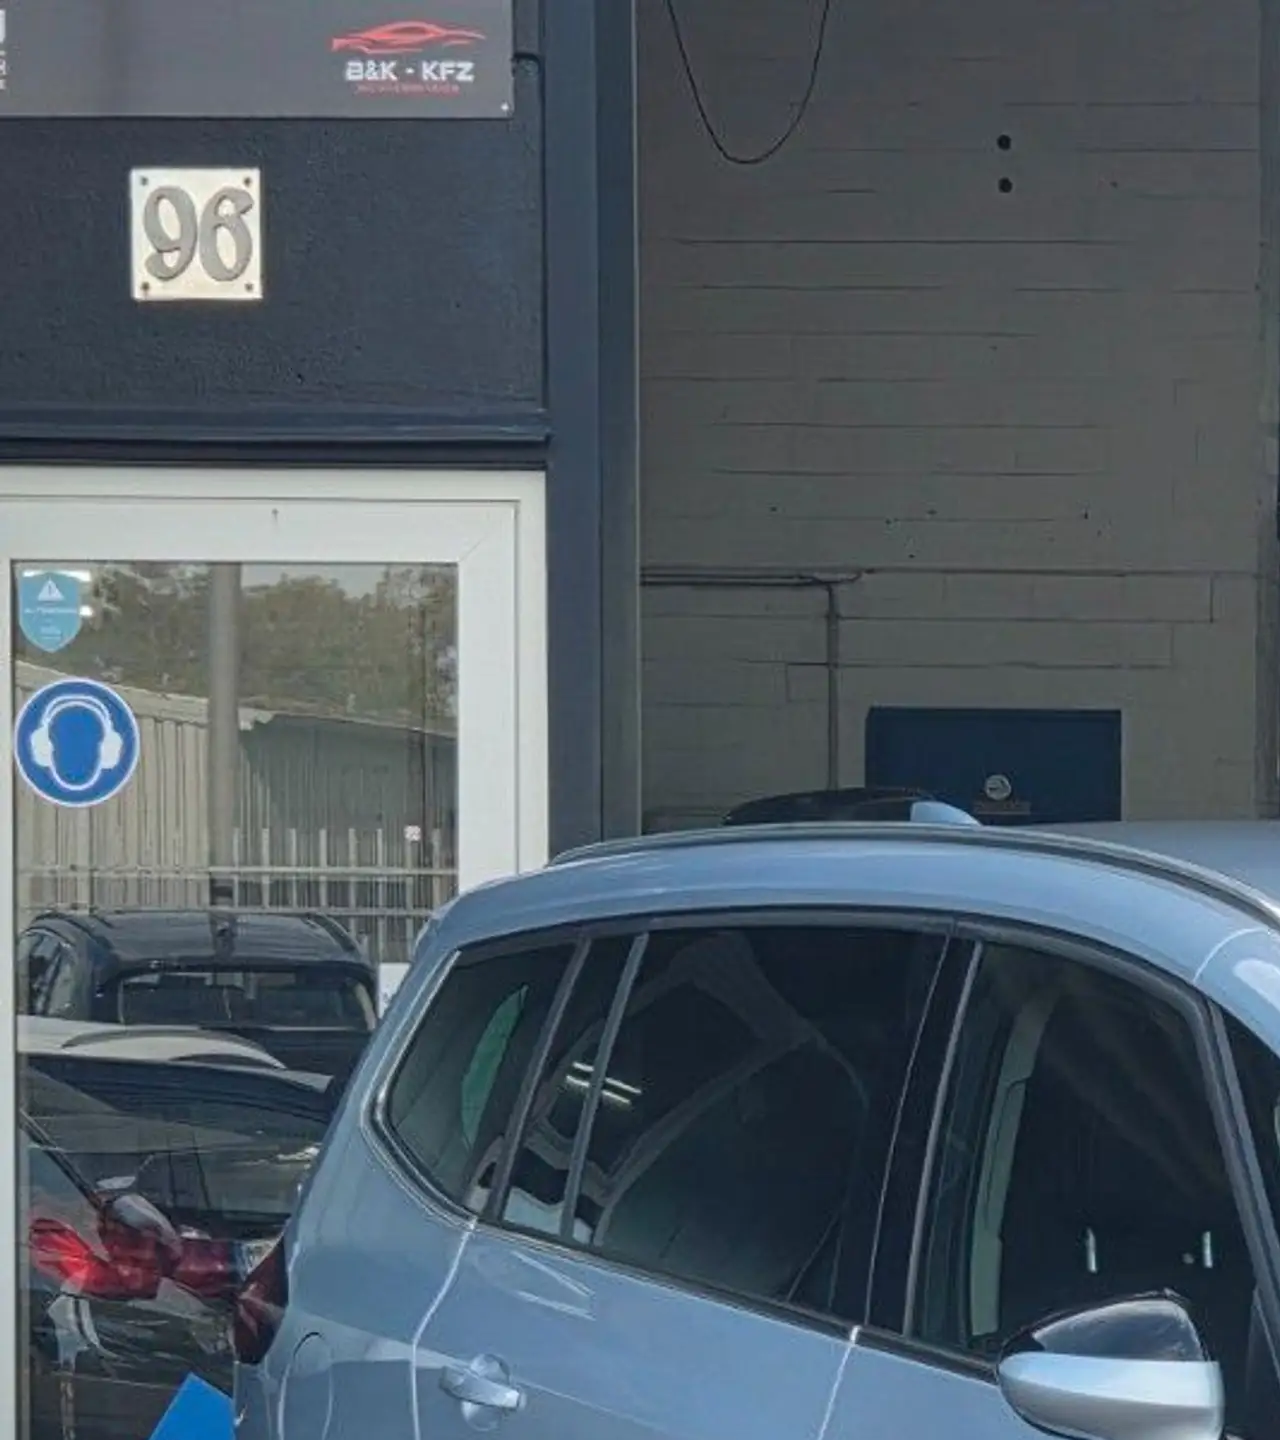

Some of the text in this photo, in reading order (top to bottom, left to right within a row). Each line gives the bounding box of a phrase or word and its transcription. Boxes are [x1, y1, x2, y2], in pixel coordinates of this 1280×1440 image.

[346, 59, 398, 81] B&K
[421, 59, 475, 81] KFZ
[143, 186, 254, 282] 96
